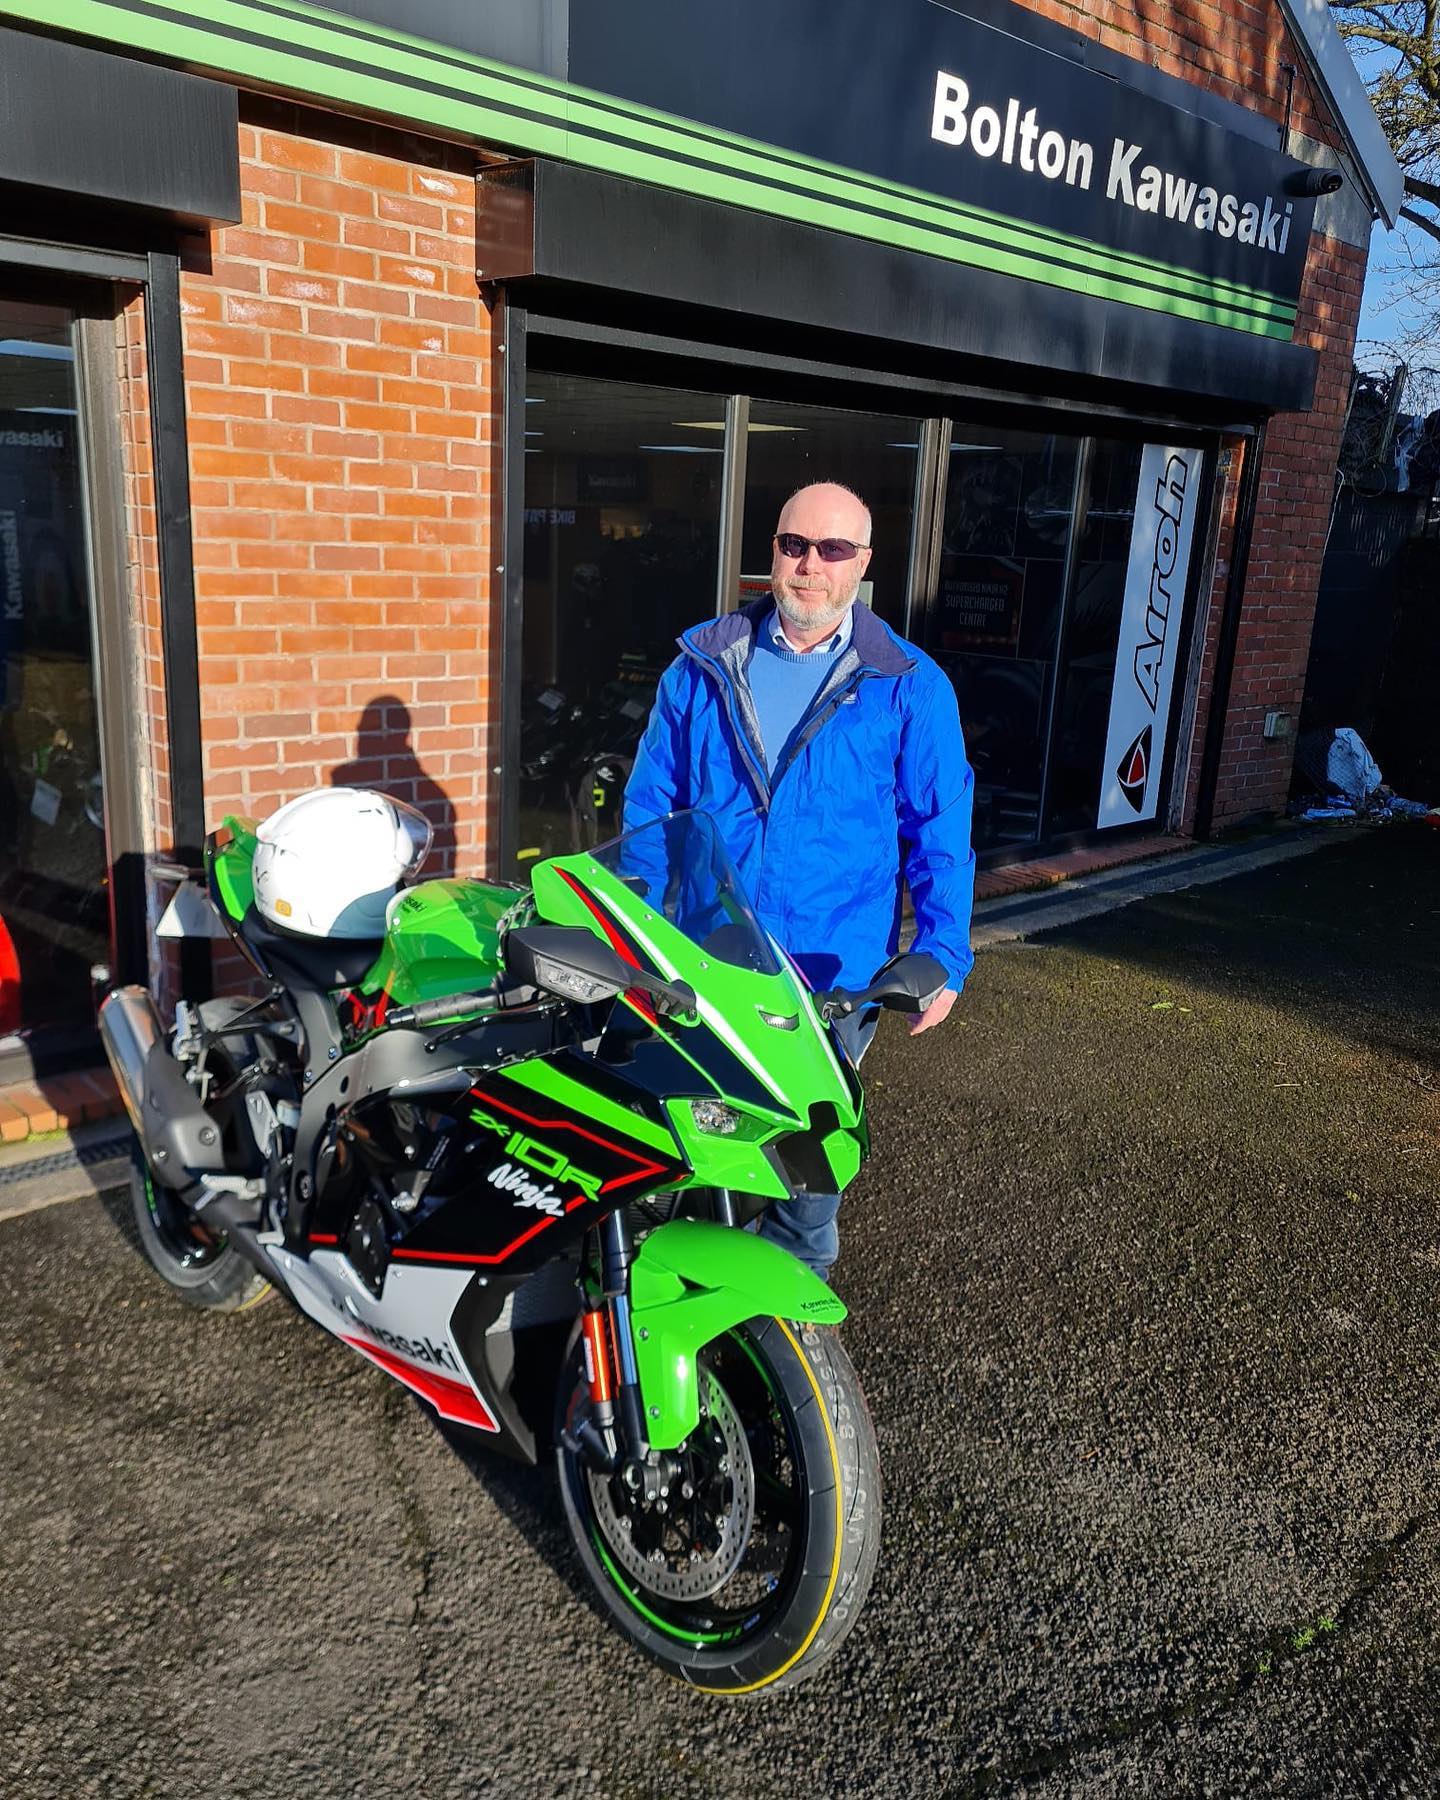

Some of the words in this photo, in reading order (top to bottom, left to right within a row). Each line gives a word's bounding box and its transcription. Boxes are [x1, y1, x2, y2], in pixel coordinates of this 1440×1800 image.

[931, 70, 1094, 191] Bolton
[1105, 137, 1293, 255] Kawasaki
[0, 510, 24, 620] Kawasaki
[944, 592, 1005, 612] SUPERCHARGED
[1133, 454, 1188, 714] Airoh
[958, 611, 988, 629] CENTRE
[486, 1163, 565, 1217] Ninja
